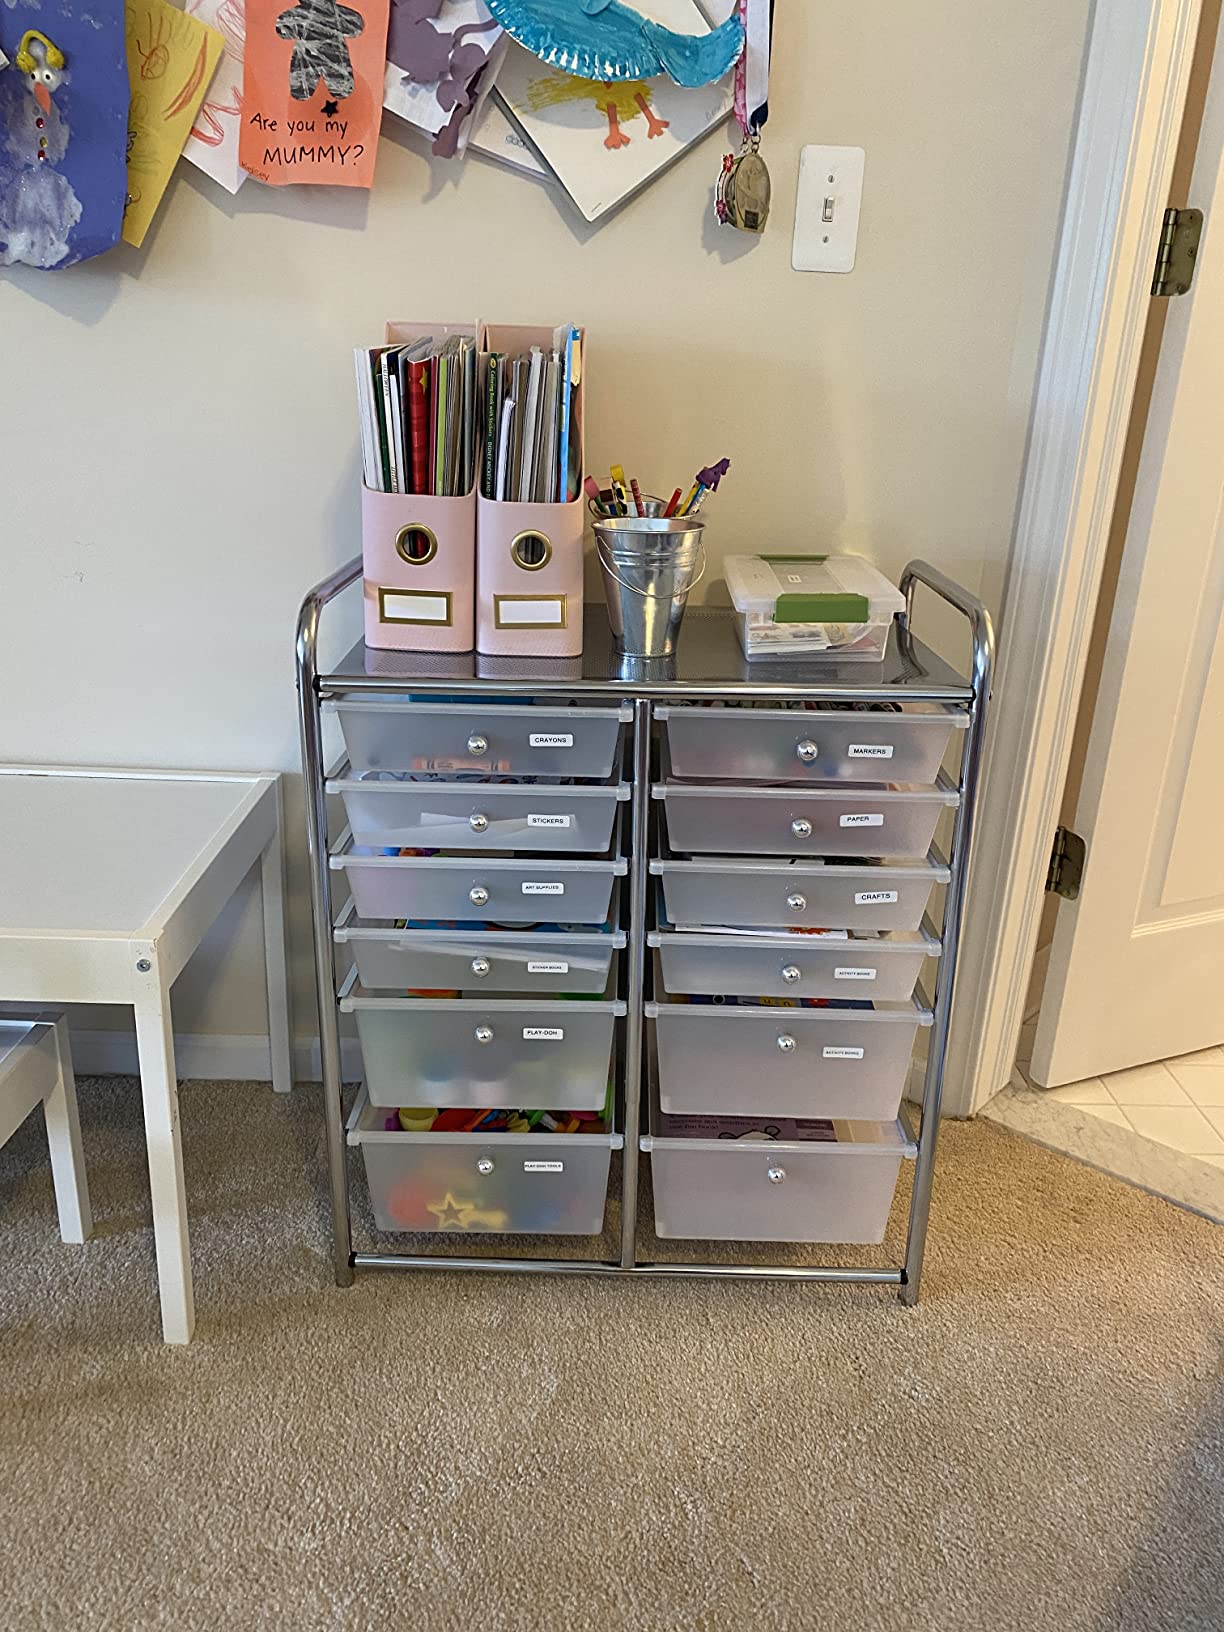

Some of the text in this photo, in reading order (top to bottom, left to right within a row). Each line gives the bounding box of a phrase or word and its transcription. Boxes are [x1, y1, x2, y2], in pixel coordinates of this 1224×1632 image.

[250, 112, 348, 140] Are you my
[262, 144, 365, 166] MUMMY?
[861, 893, 891, 901] CRAFTS
